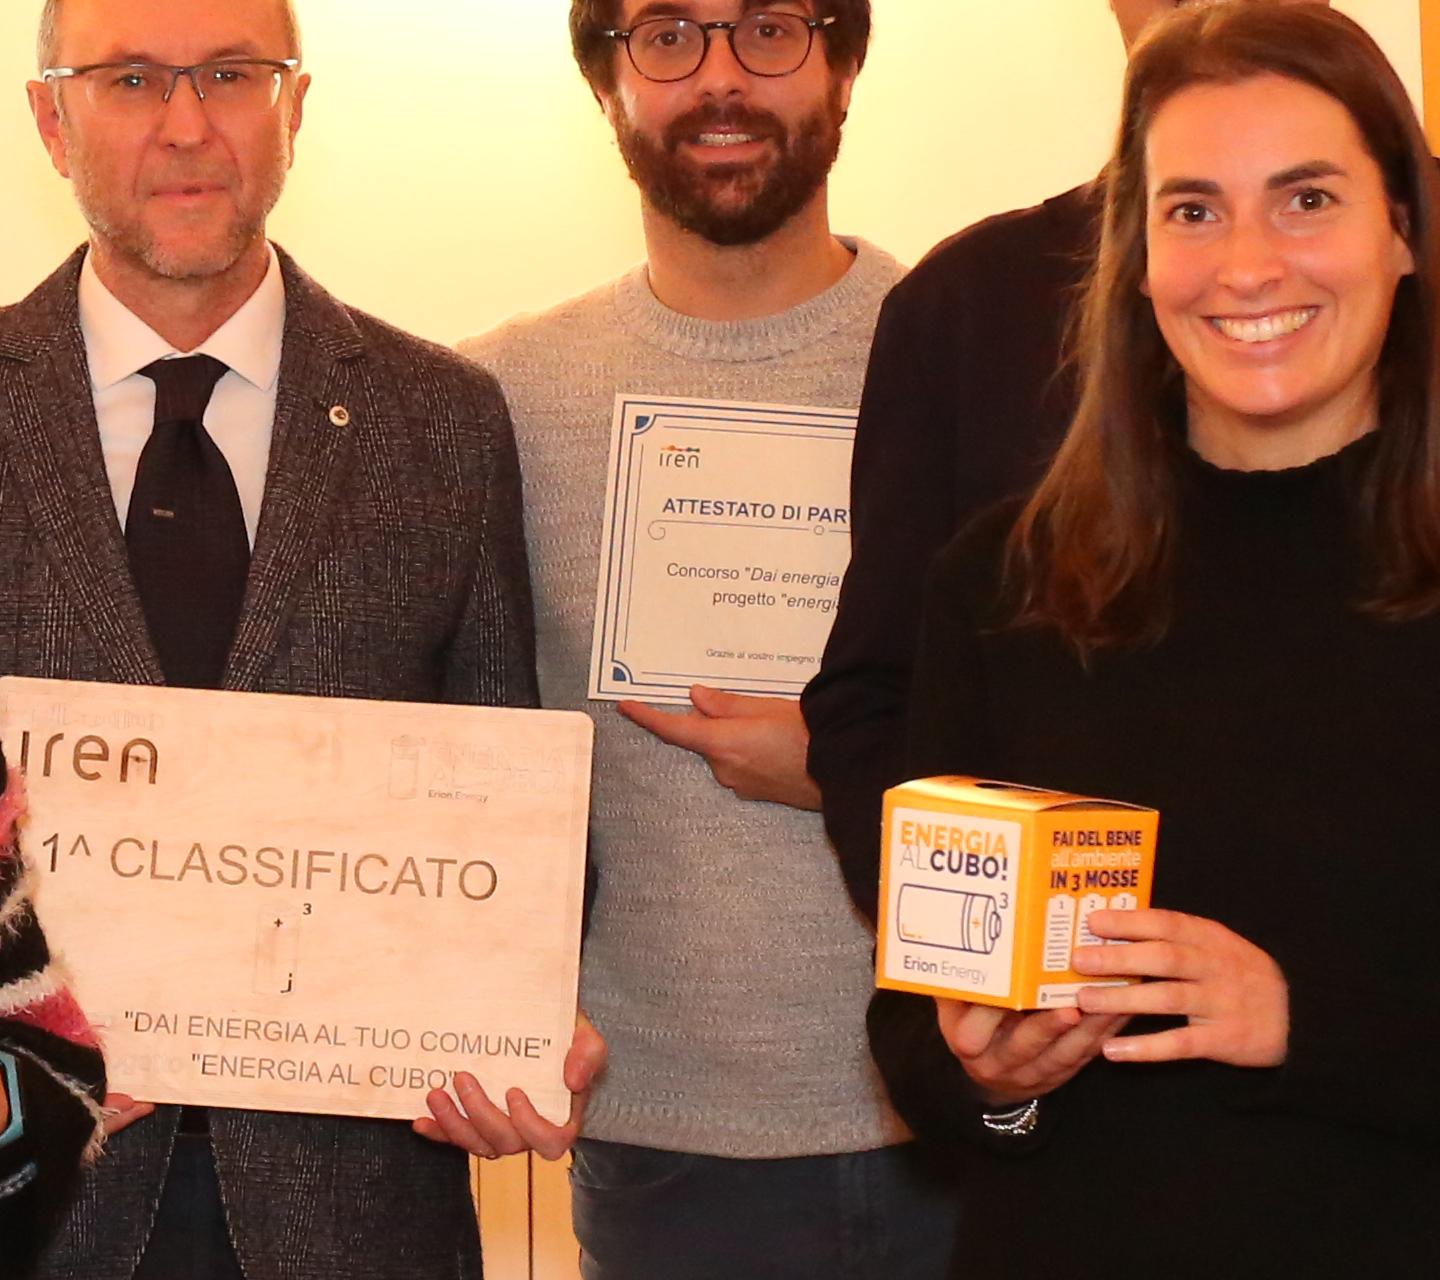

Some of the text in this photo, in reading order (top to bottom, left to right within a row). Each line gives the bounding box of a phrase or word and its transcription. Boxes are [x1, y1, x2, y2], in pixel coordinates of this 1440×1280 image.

[662, 497, 851, 524] ATTESTATO DI PAR
[666, 562, 840, 590] Concorso "Dai energia
[712, 590, 776, 609] progetto
[777, 652, 815, 665] impegno
[900, 821, 1008, 857] ENERGIA
[1052, 830, 1142, 847] FAI DEL BENE
[109, 836, 499, 902] CLASSIFICATO
[929, 849, 1009, 882] CUBO!
[1050, 869, 1139, 892] IN 3 MOSSE
[999, 892, 1009, 910] 3
[903, 955, 989, 985] Erion Energy
[123, 1009, 551, 1059] "DAI ENERGIA AL TUO COMUNE"
[191, 1053, 457, 1090] "ENERGIA AL CUBO"
